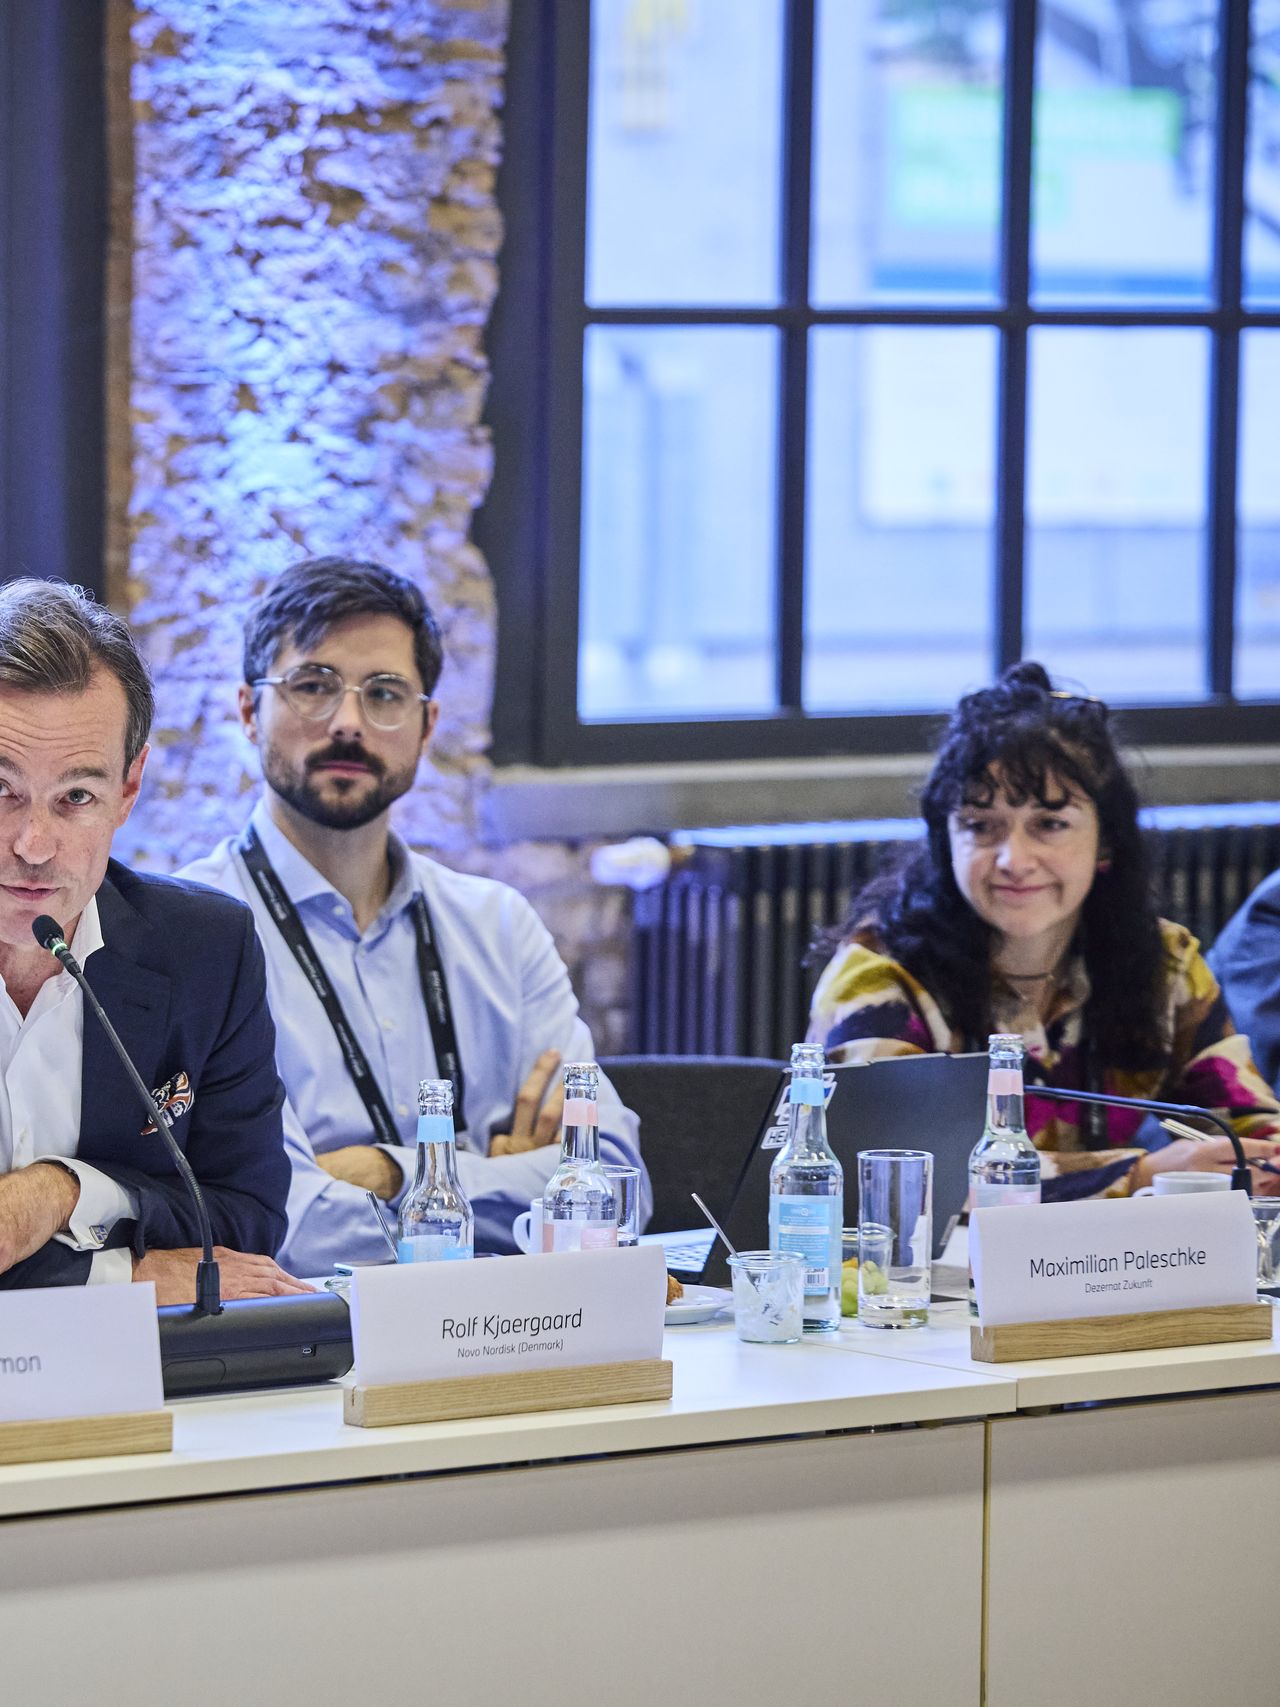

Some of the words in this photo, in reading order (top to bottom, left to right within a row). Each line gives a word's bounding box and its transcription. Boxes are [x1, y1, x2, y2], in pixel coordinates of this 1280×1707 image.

[1029, 1254, 1118, 1278] Maximilian
[1123, 1246, 1207, 1271] Paleschke
[1123, 1278, 1153, 1290] Zukunft
[442, 1315, 478, 1340] Rolf
[483, 1308, 582, 1339] Kjaergaard
[457, 1347, 481, 1358] Novo
[483, 1344, 516, 1356] Nordisk
[518, 1339, 564, 1355] (Denmark)
